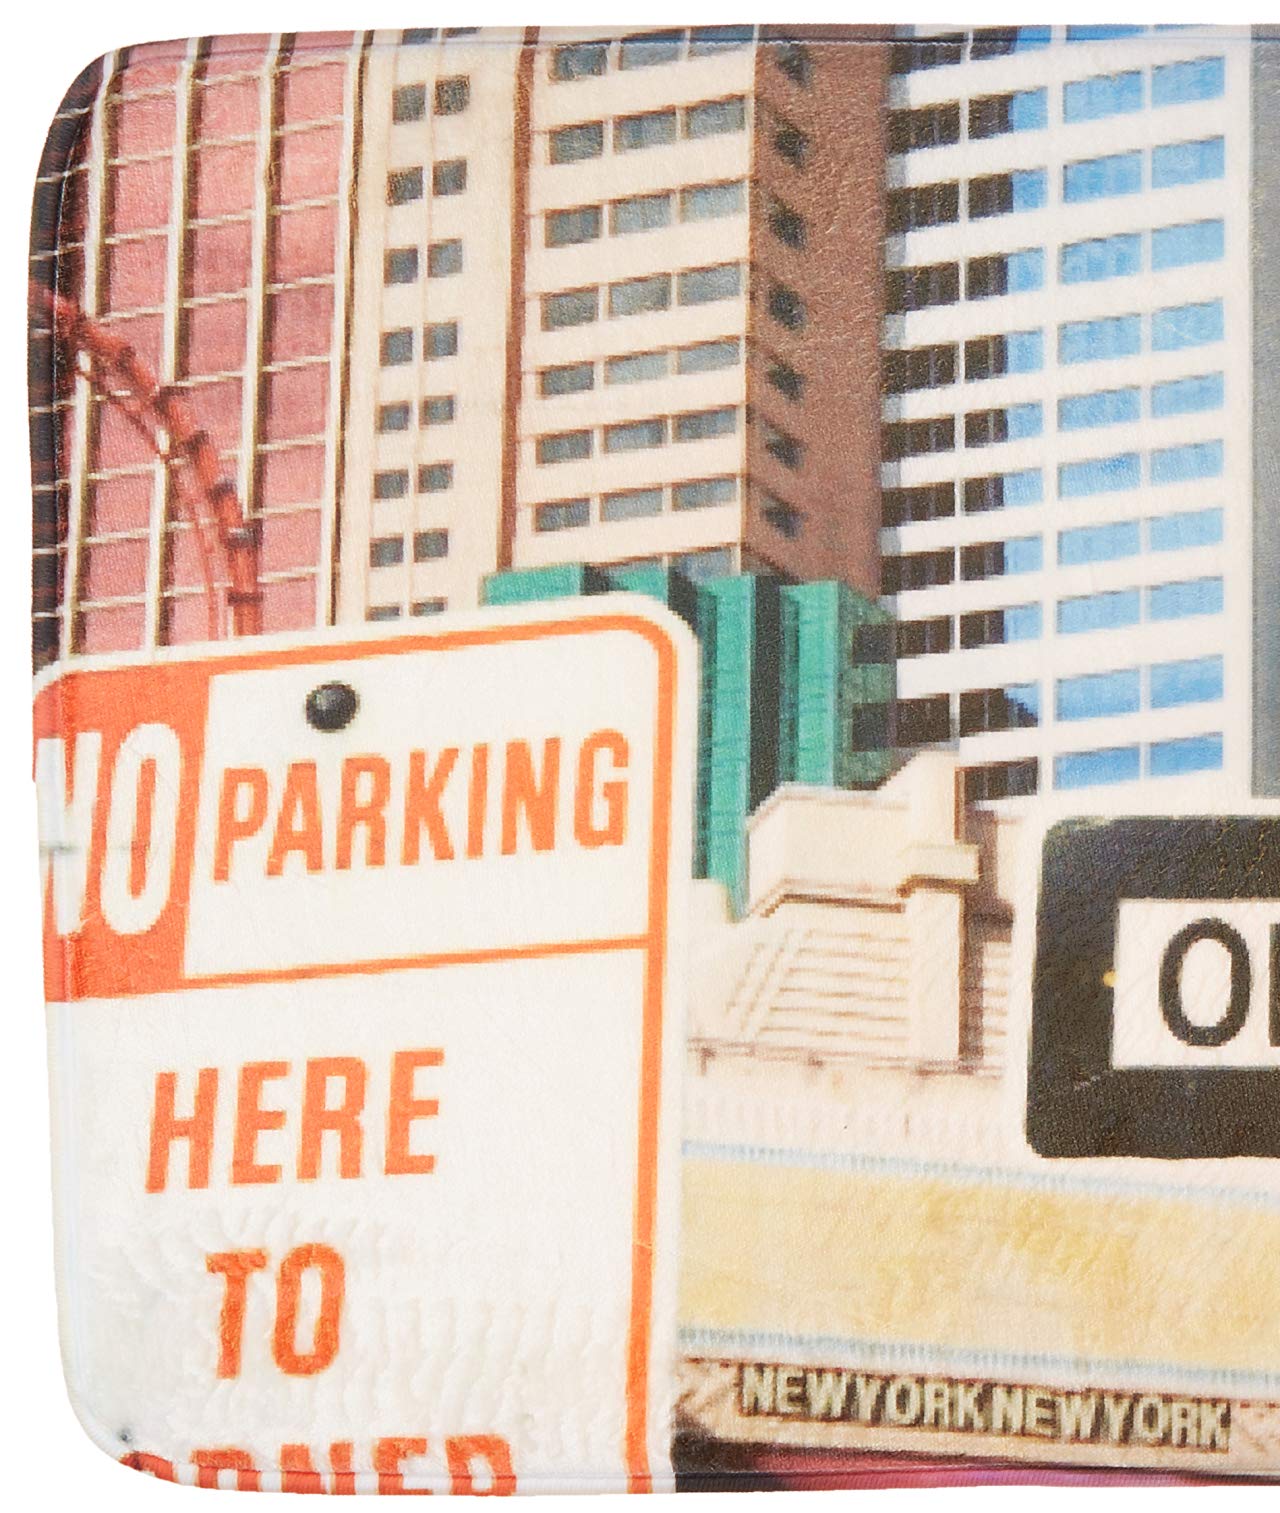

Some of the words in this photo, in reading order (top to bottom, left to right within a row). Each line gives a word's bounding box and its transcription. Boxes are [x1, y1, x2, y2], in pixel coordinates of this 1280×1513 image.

[36, 723, 181, 935] NO
[213, 730, 630, 882] PARKING
[145, 1047, 445, 1194] HERE
[205, 1242, 346, 1380] TO
